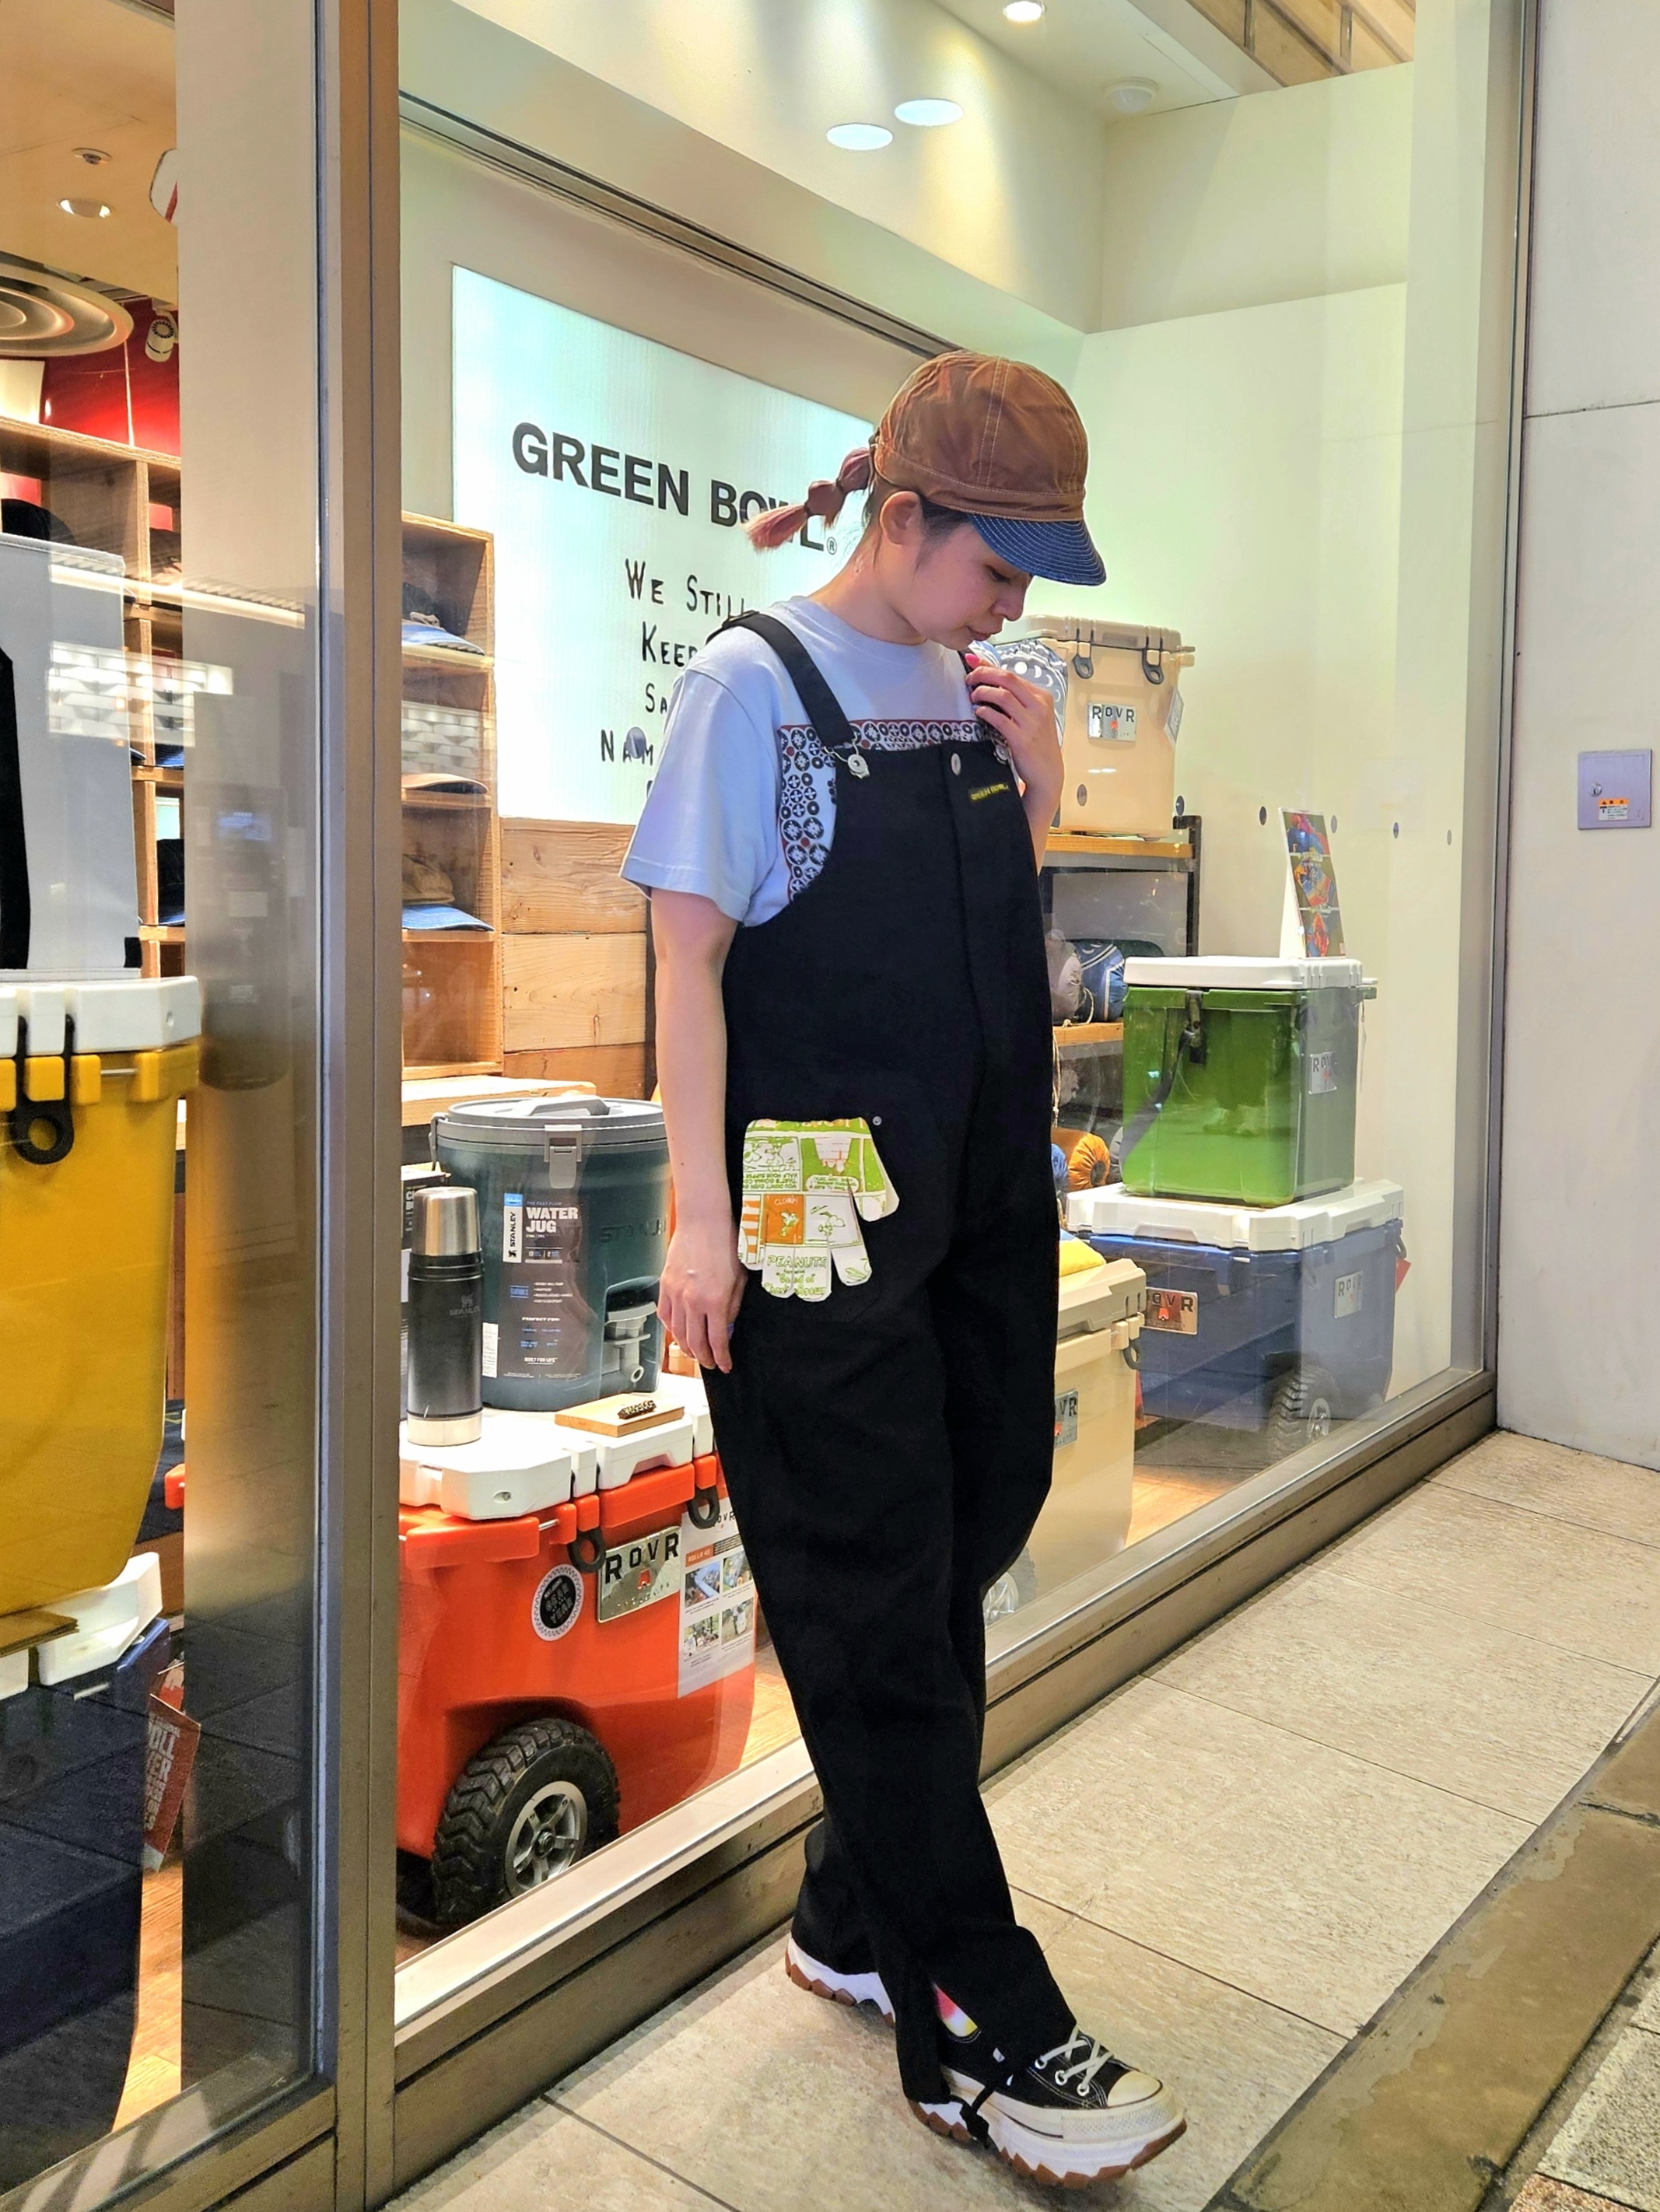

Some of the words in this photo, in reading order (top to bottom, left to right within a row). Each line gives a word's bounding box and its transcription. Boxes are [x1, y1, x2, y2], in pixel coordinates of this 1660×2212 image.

[512, 422, 688, 516] GREEN
[711, 479, 825, 552] BOL
[1092, 705, 1135, 723] ROVR
[526, 1207, 578, 1220] WATER
[525, 1220, 557, 1234] JUG
[766, 1255, 827, 1269] PEANUTS
[1152, 1293, 1194, 1313] OVR
[605, 1532, 678, 1584] ROVR
